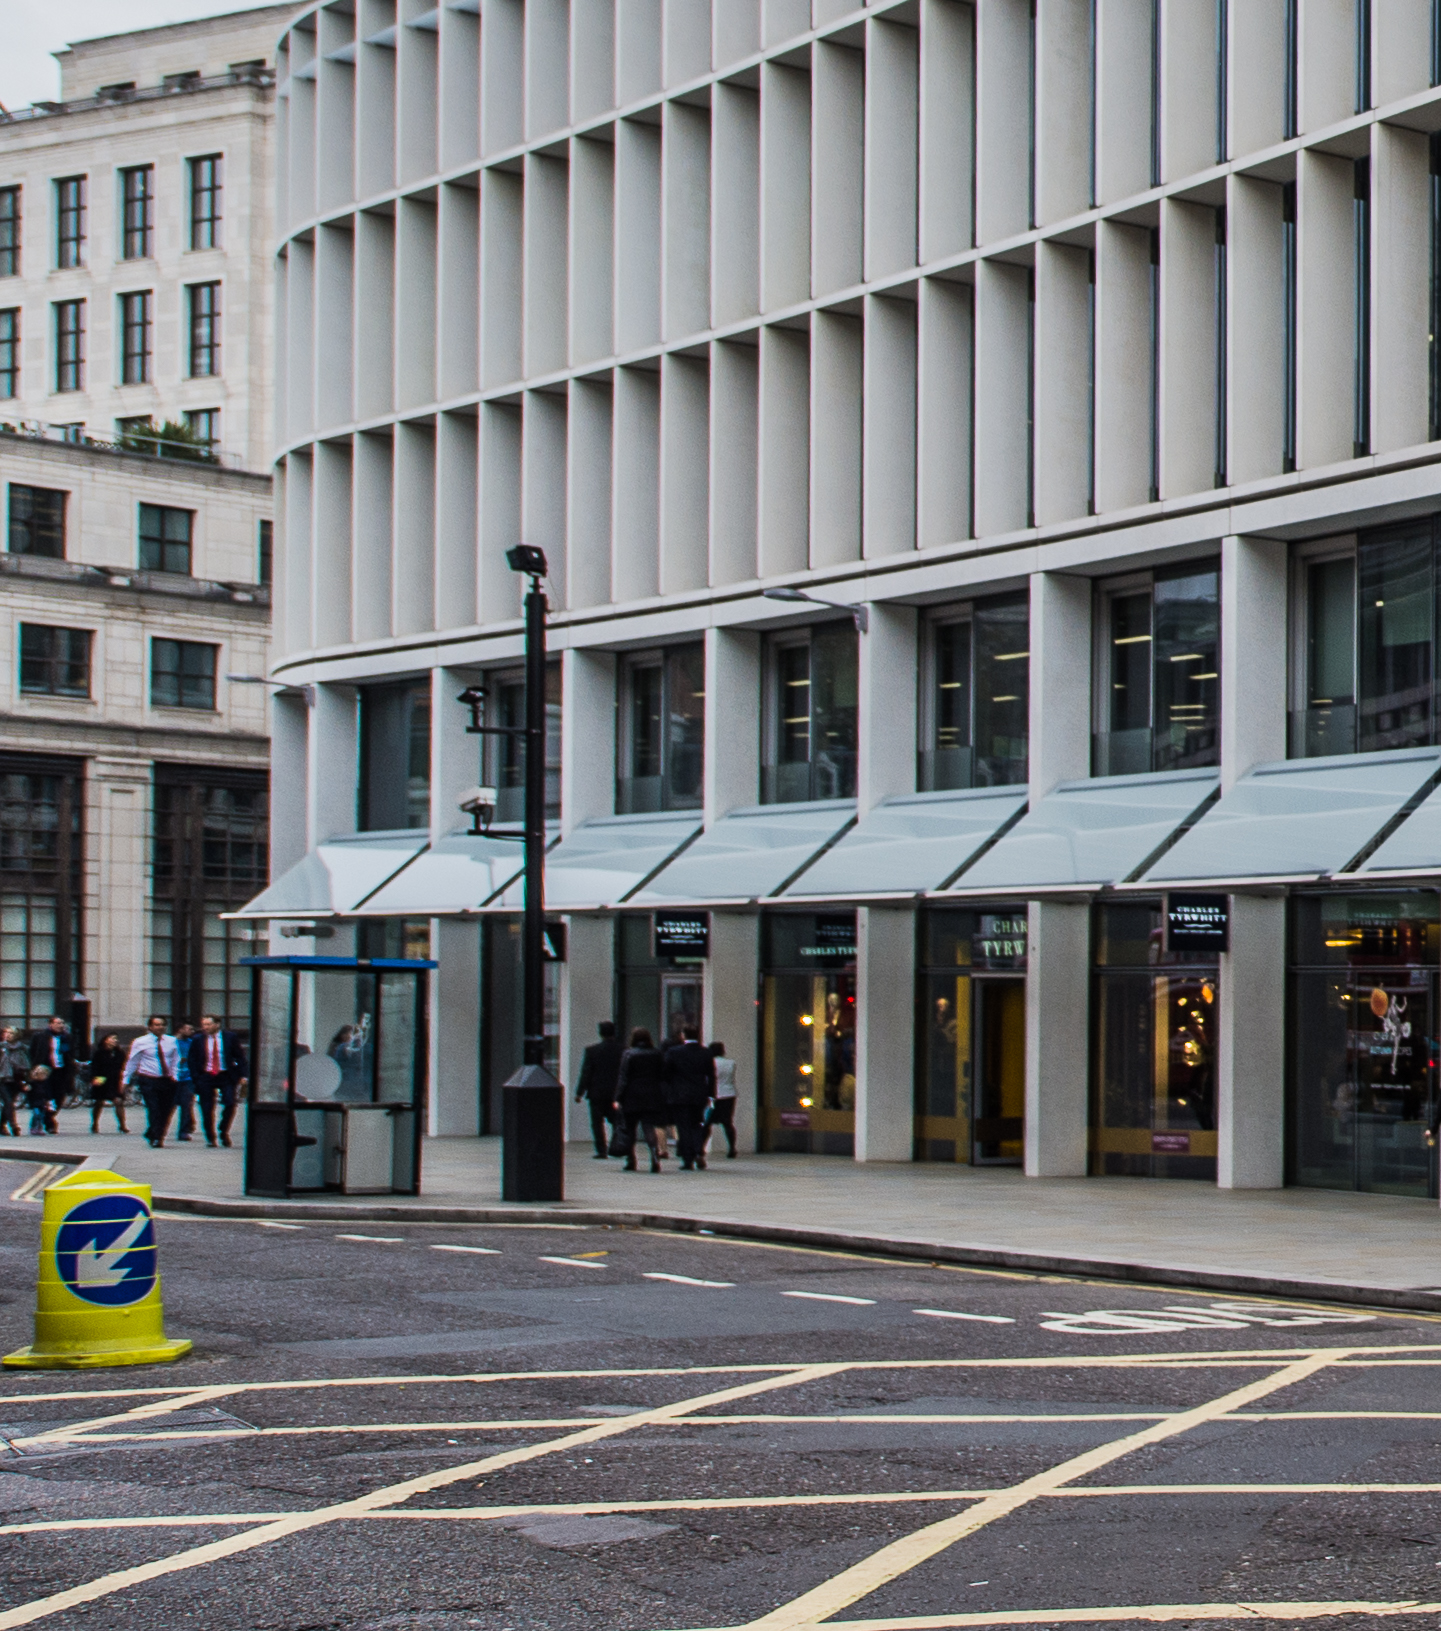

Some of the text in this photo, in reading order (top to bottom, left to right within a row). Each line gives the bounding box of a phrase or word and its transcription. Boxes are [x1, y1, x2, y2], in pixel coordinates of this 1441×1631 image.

[1176, 906, 1220, 914] CHARLES
[1168, 913, 1227, 922] TYRWHITT
[1039, 1302, 1377, 1335] STOP
